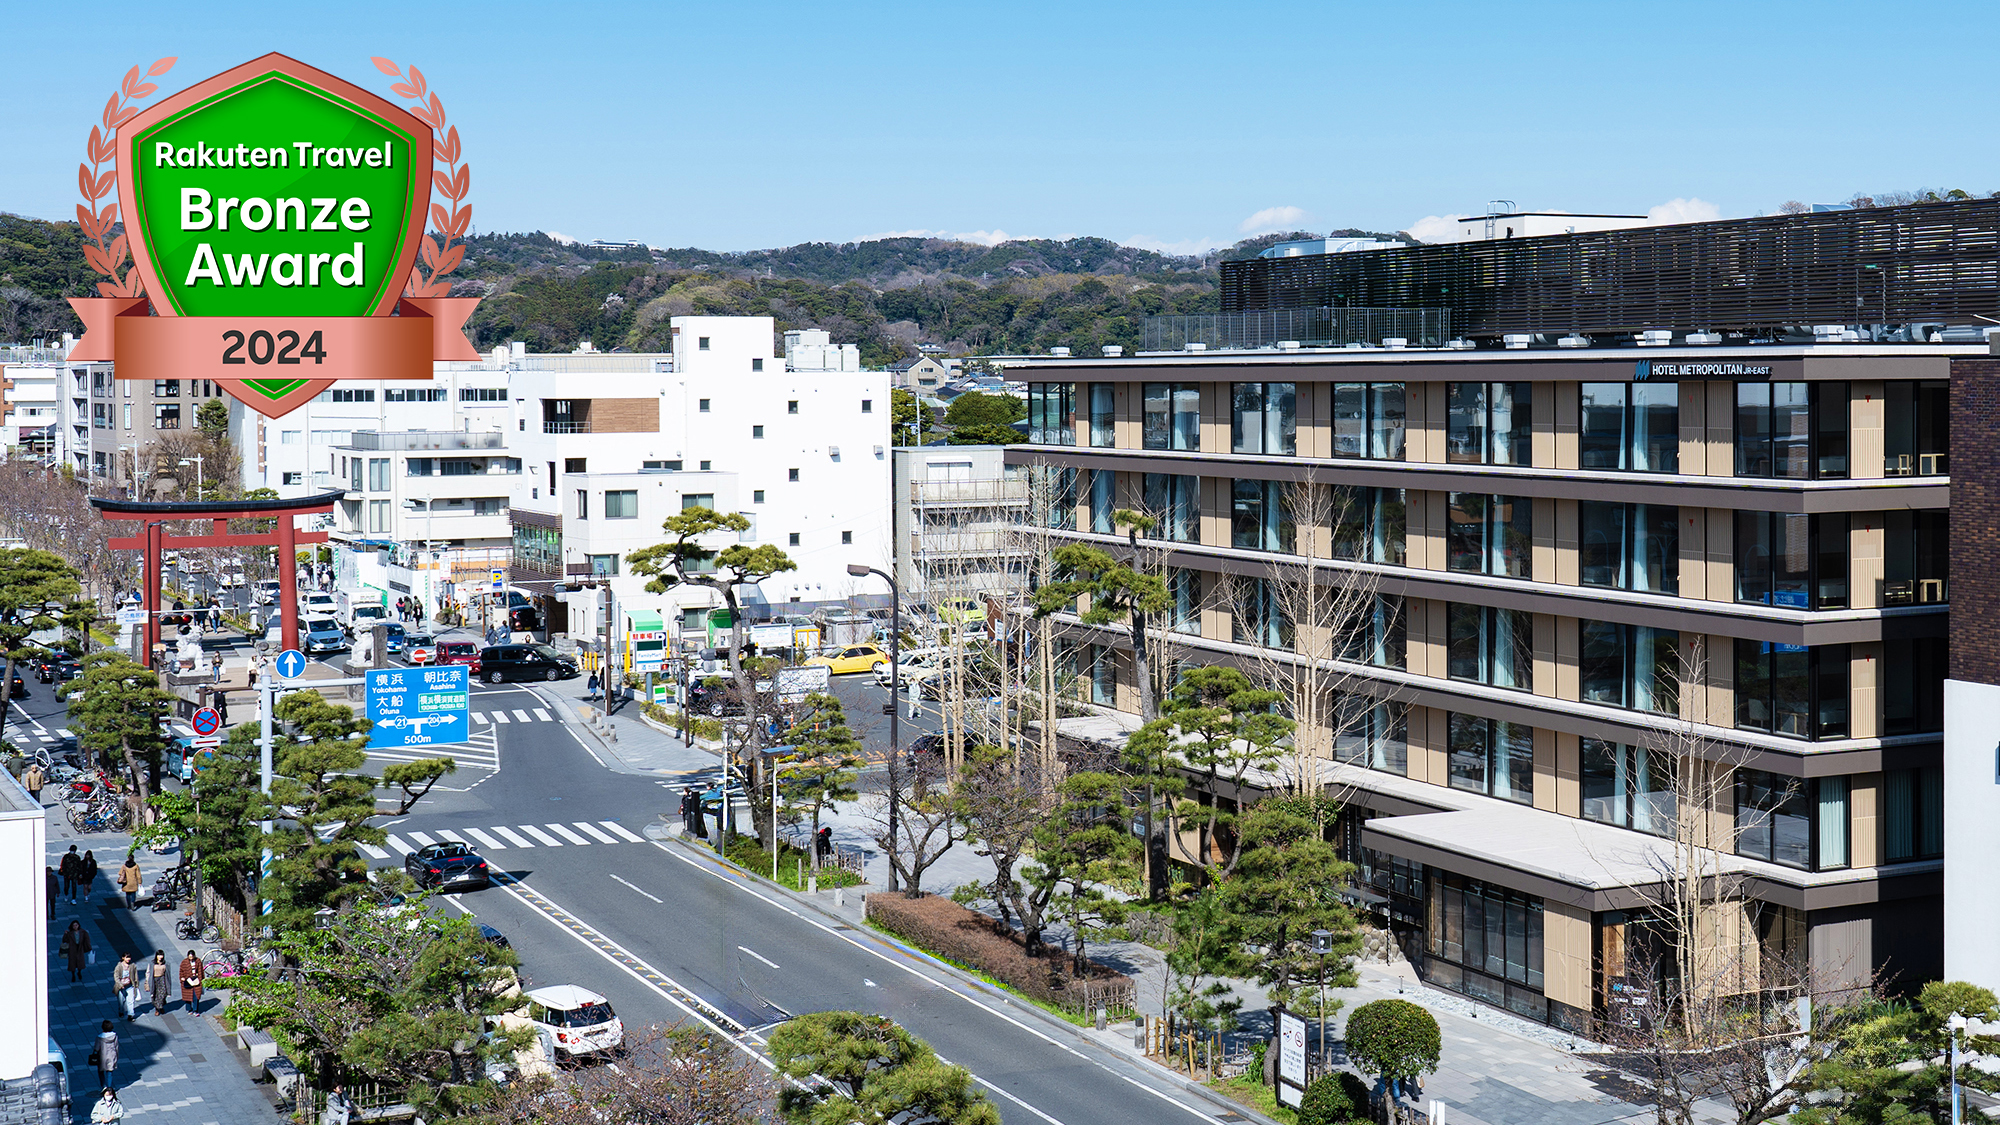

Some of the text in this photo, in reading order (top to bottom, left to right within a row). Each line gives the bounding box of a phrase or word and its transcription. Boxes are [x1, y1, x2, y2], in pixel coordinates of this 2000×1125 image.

[1652, 363, 1770, 375] HOTEL METROPOLITAN JR-EAST
[492, 572, 502, 584] P
[376, 673, 404, 686] 横浜
[424, 670, 462, 683] 朝比奈
[372, 686, 408, 694] Yokohama
[376, 695, 404, 708] 大船
[396, 718, 406, 727] 21
[404, 734, 432, 744] 500m
